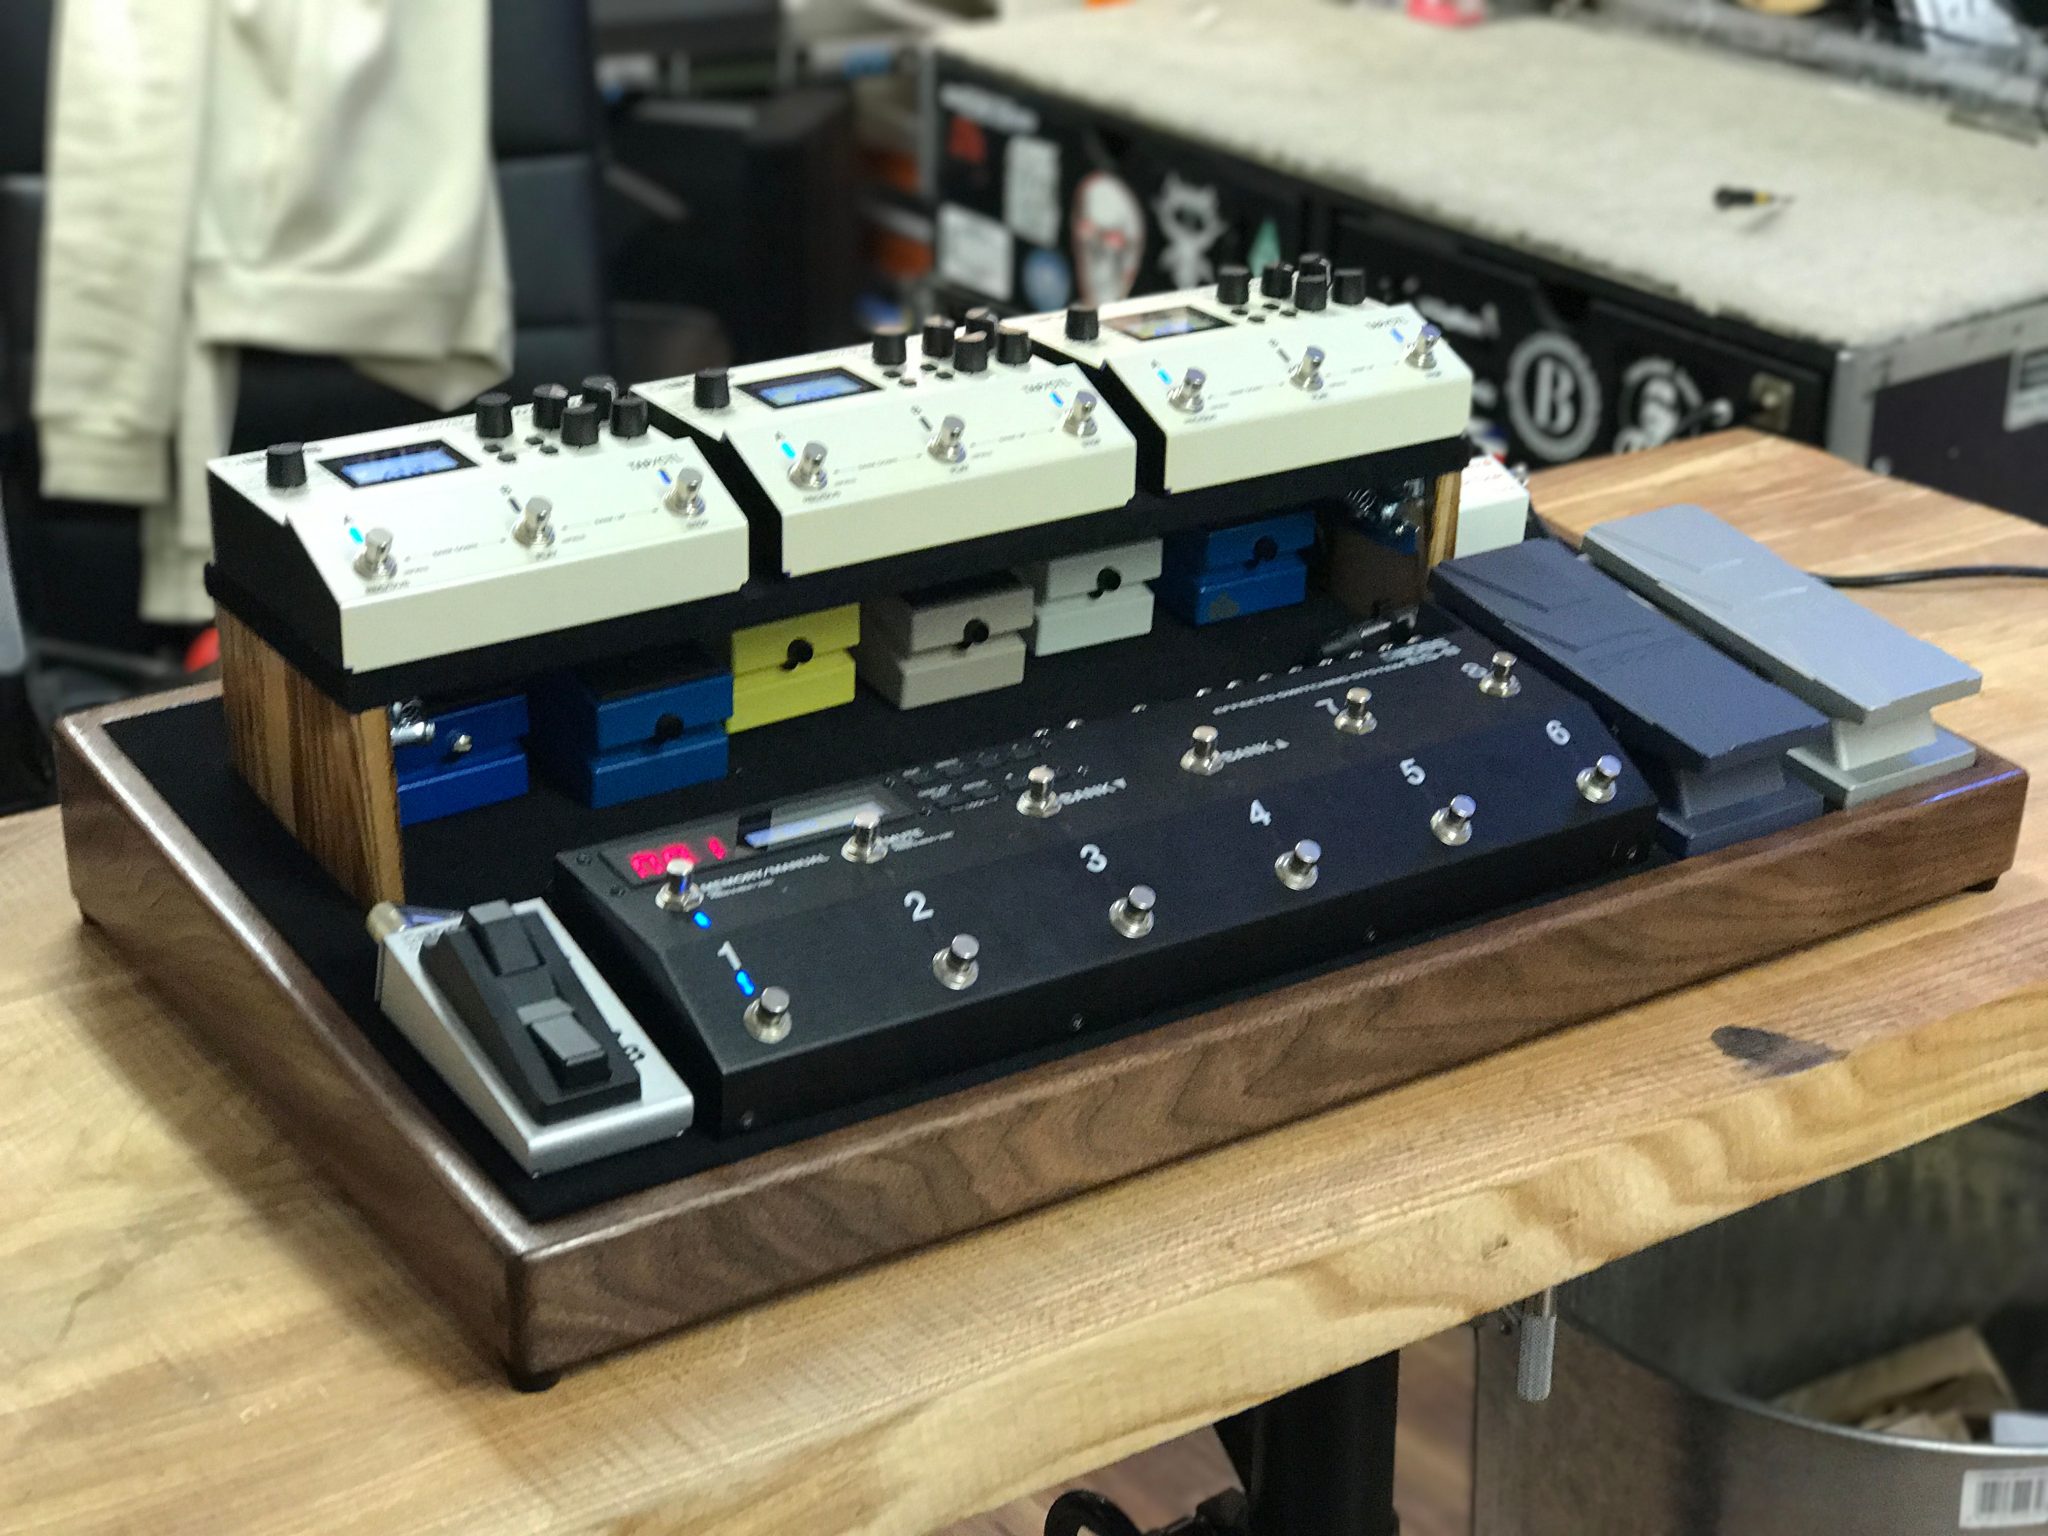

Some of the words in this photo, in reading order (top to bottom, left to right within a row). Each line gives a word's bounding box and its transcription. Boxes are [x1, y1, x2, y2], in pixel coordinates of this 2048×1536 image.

[1534, 355, 1576, 434] B
[1546, 719, 1571, 745] 6
[1400, 757, 1426, 786] 5
[1250, 799, 1271, 826] 4
[1080, 844, 1108, 873] 3
[904, 890, 934, 923] 2
[717, 940, 742, 971] 1
